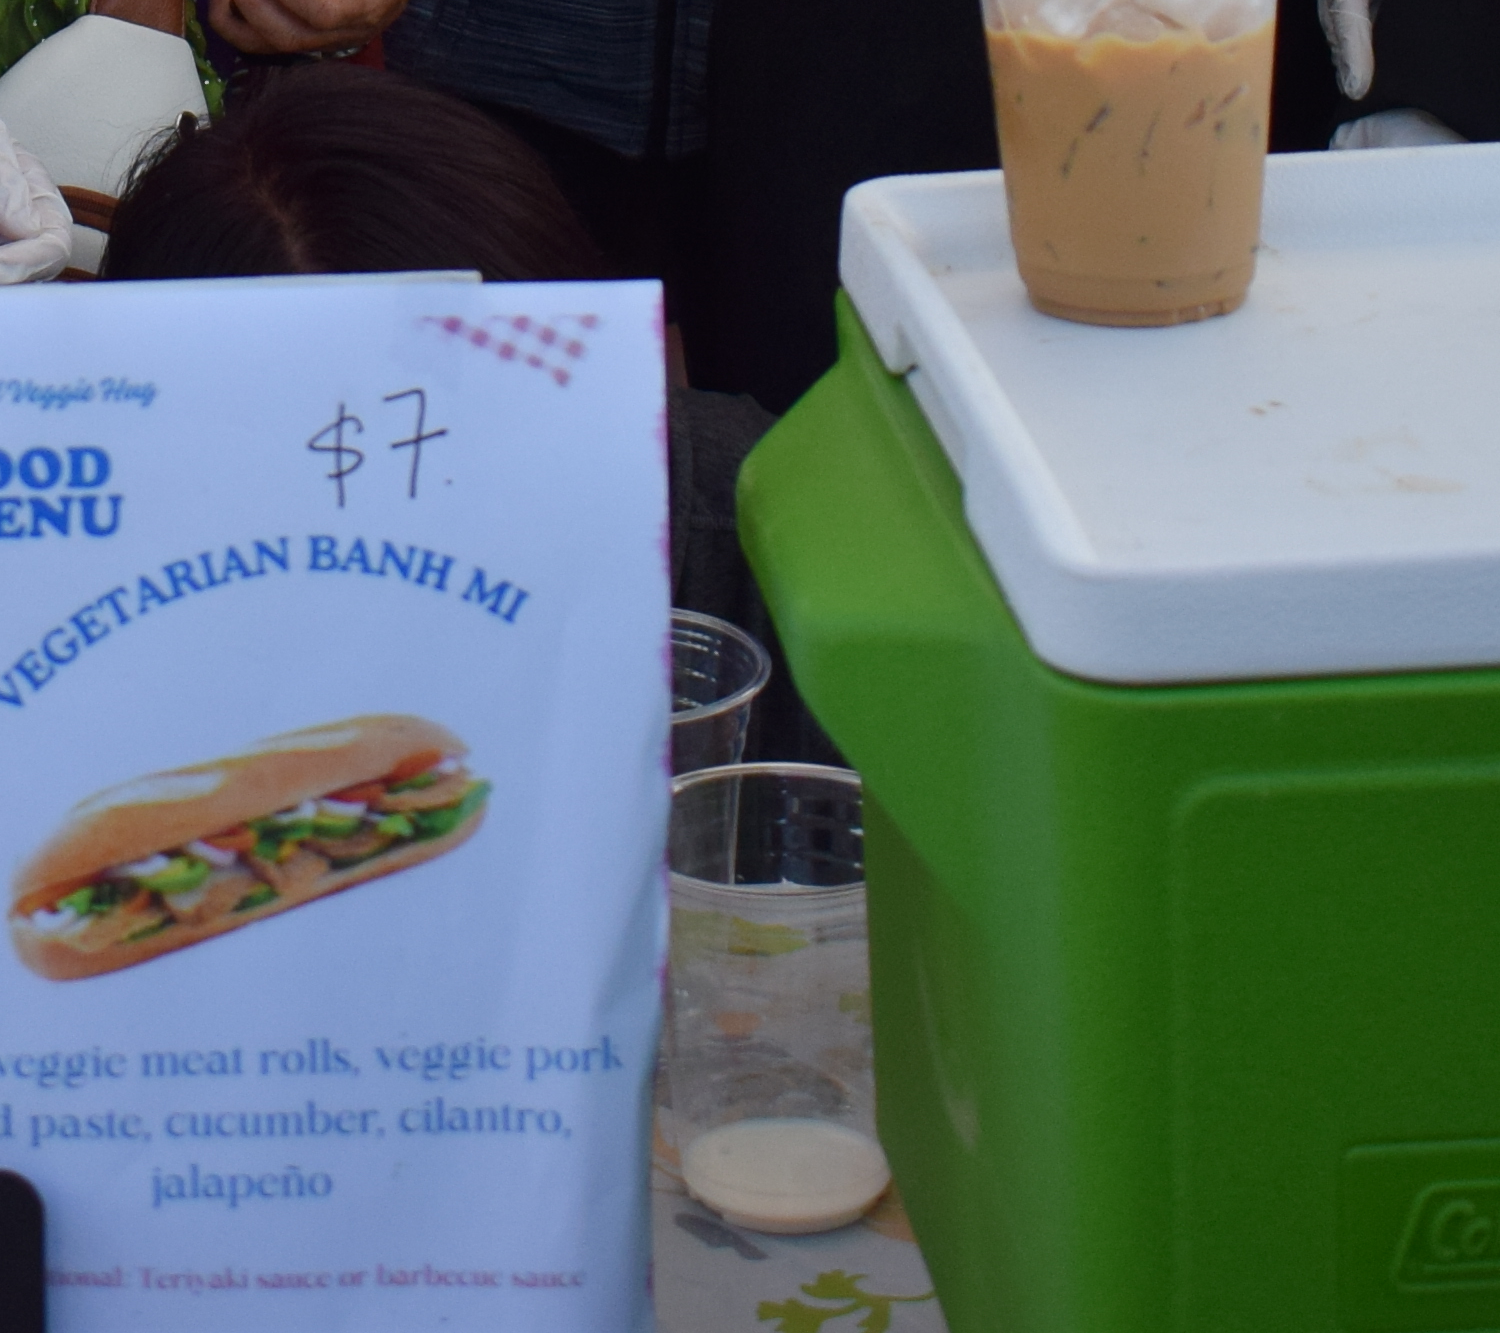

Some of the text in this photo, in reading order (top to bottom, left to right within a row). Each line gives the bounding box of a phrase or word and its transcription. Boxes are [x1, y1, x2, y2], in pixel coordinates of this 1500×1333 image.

[9, 377, 95, 412] Veggie
[101, 377, 159, 409] Hug
[307, 536, 456, 594] BANH
[461, 568, 533, 625] MI
[141, 1047, 245, 1079] meat
[259, 1037, 361, 1077] rolls,
[375, 1036, 512, 1083] veggie
[525, 1035, 624, 1082] pork
[30, 1110, 152, 1149] paste,
[165, 1099, 387, 1139] cucumber,
[400, 1095, 573, 1139] cilantro,
[151, 1162, 335, 1210] jalapeño
